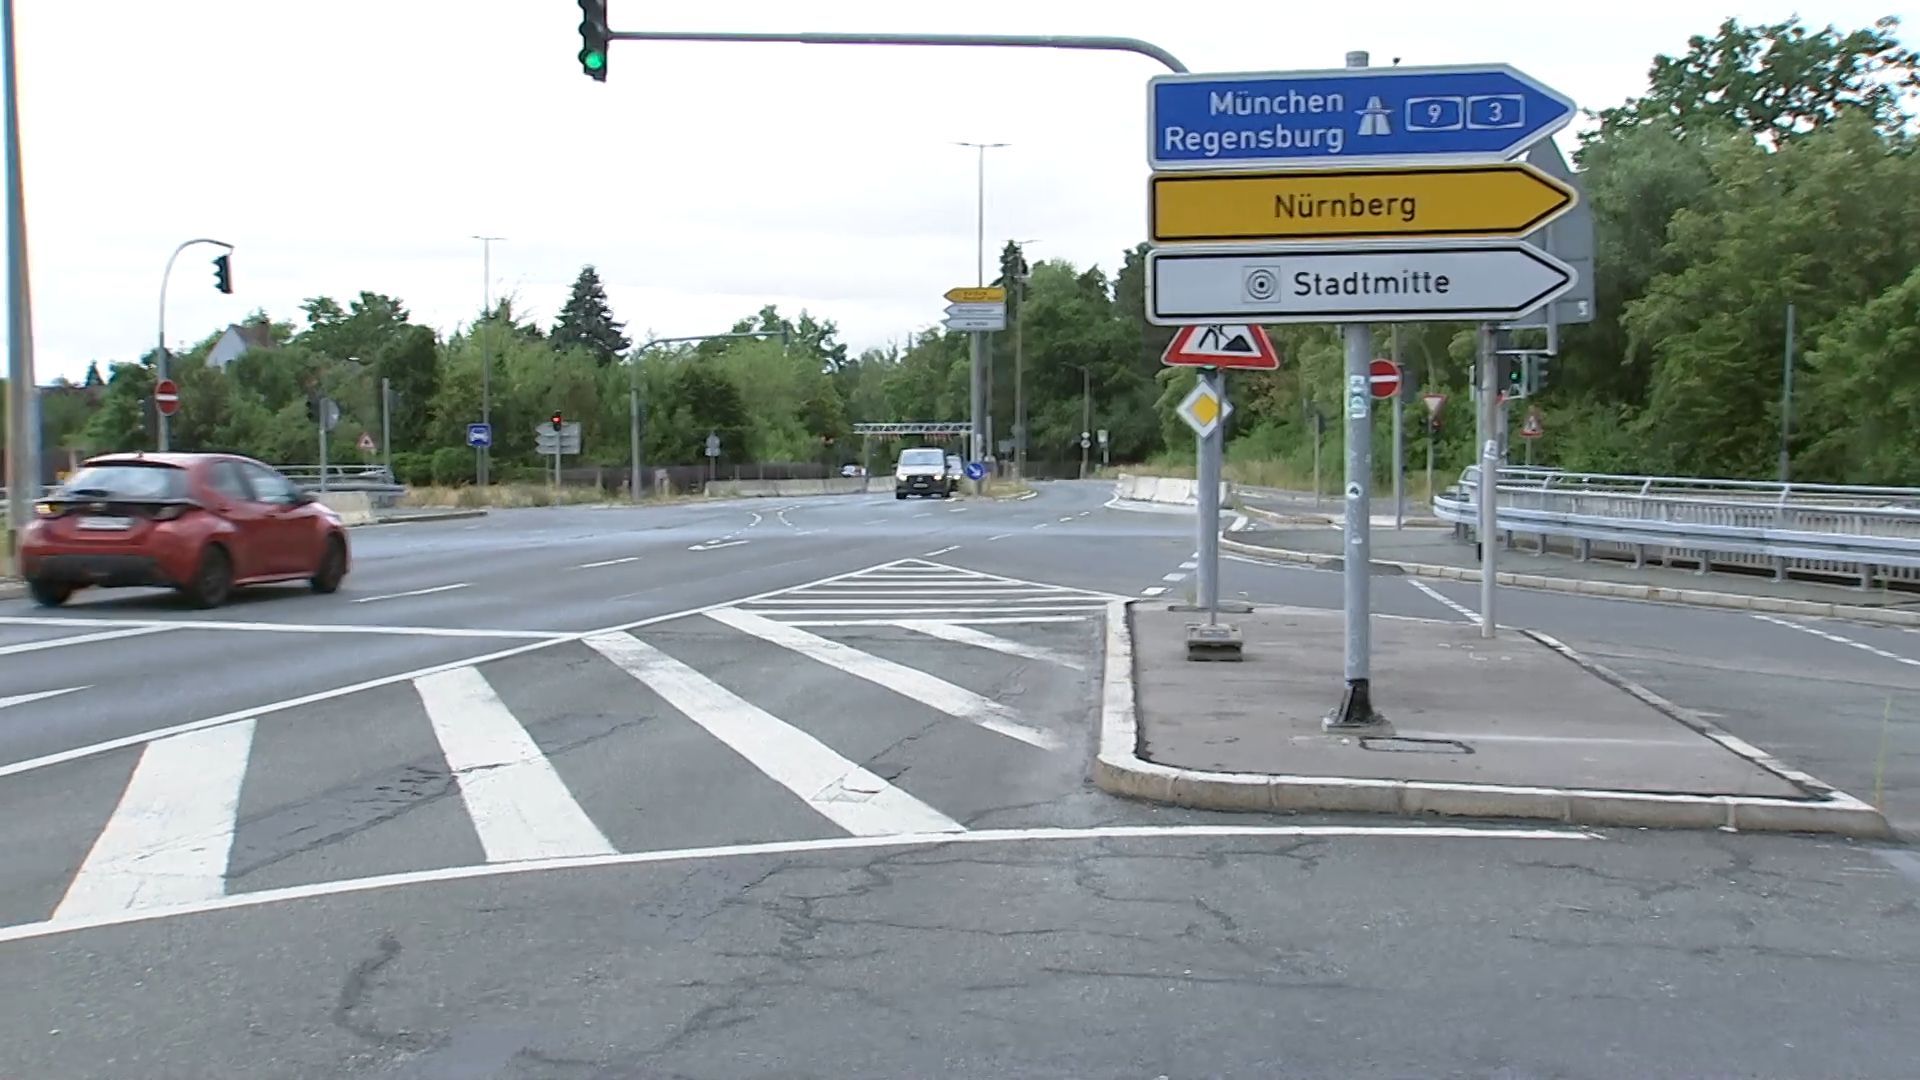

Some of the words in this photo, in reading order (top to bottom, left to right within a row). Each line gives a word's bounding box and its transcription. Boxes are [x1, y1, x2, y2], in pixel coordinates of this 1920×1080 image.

[1210, 89, 1344, 117] München
[1427, 104, 1441, 123] 9
[1488, 102, 1502, 121] 3
[1164, 124, 1345, 156] Regensburg
[1274, 192, 1417, 222] Nürnberg
[1293, 270, 1450, 297] Stadtmitte
